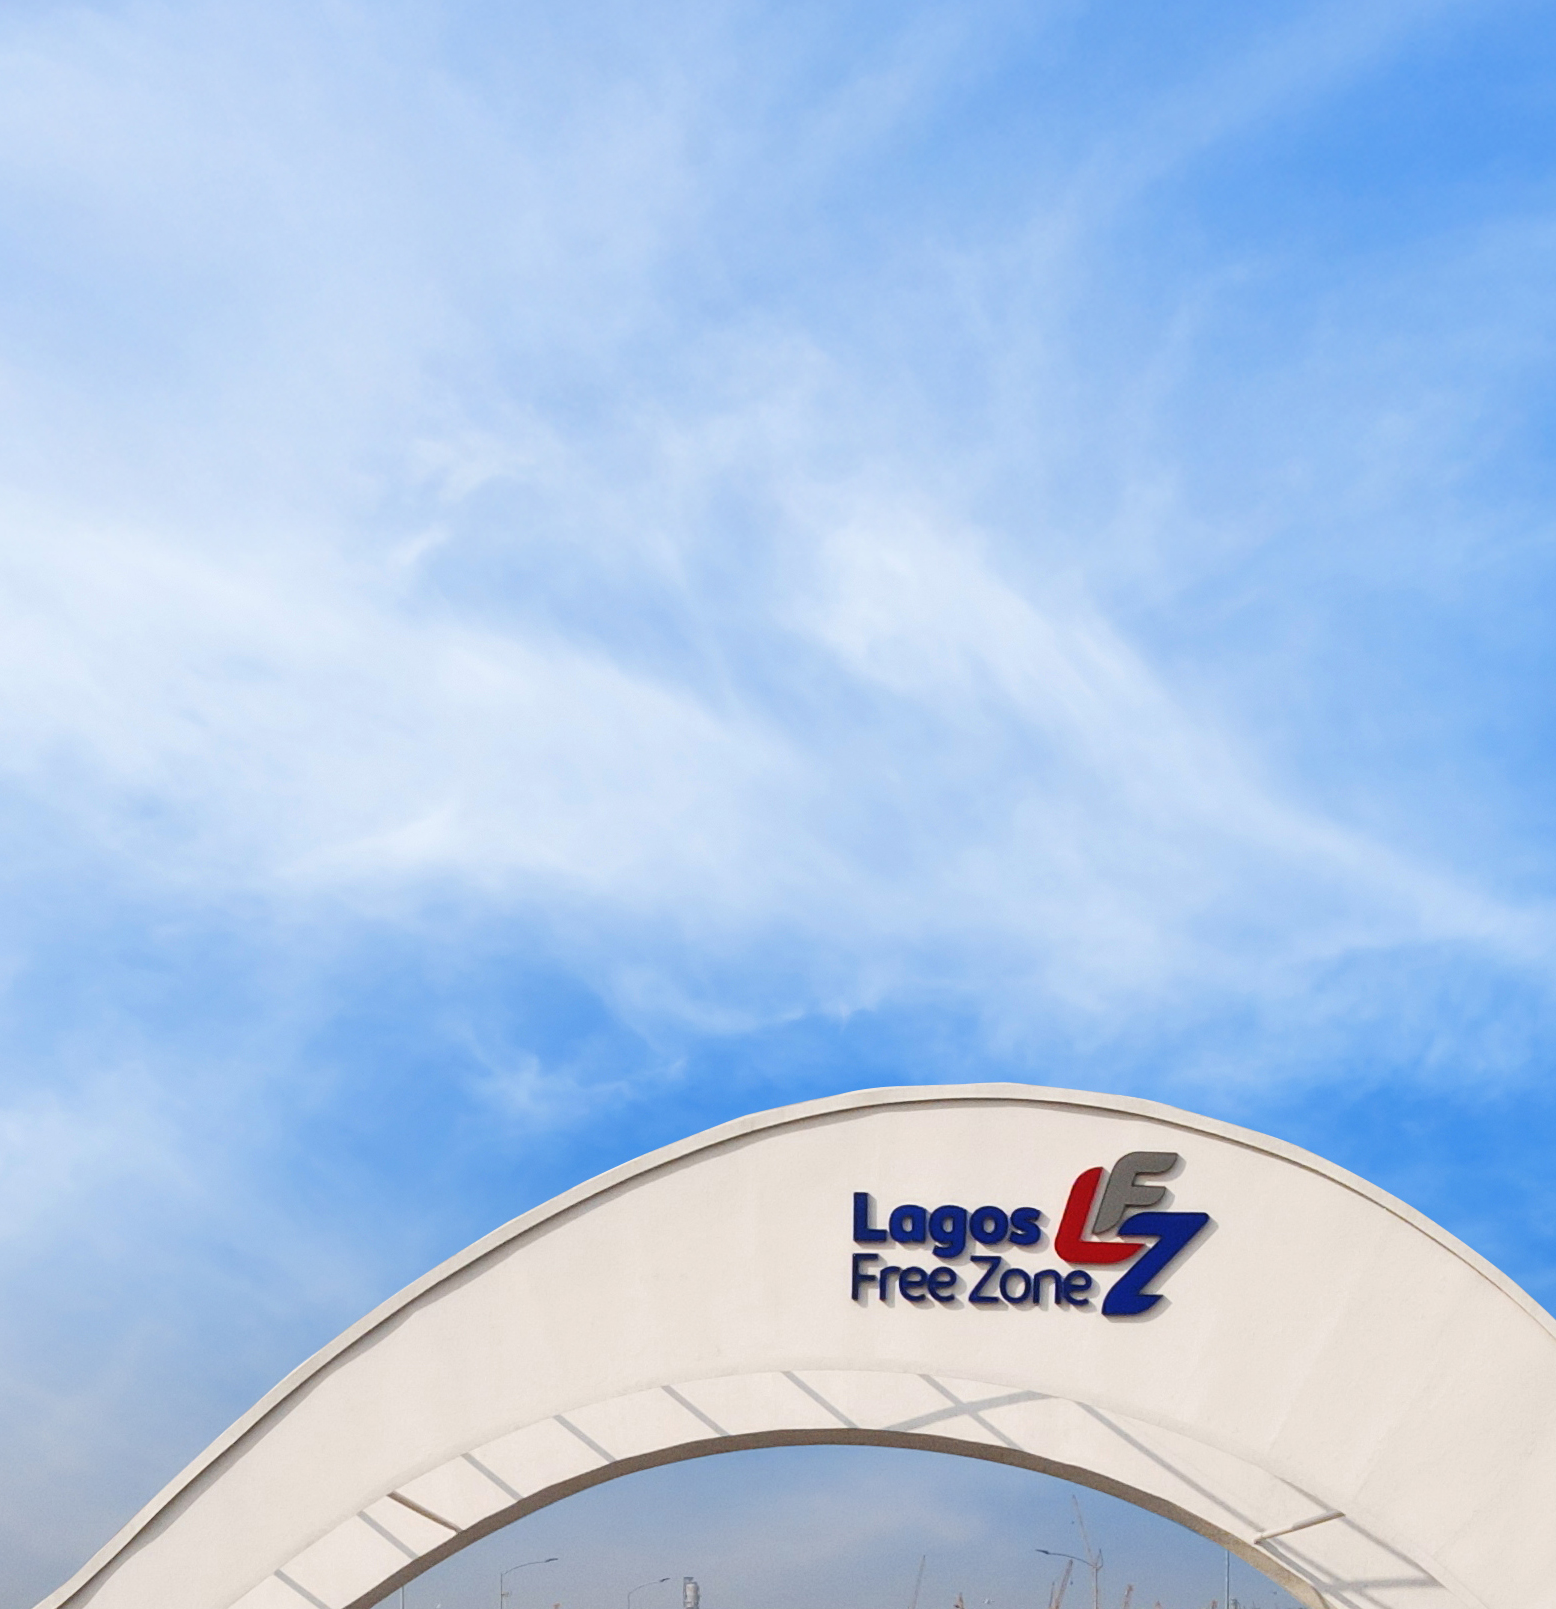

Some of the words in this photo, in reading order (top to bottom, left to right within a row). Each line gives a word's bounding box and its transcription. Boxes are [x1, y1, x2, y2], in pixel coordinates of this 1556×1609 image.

[853, 1192, 1041, 1258] Lagos
[851, 1253, 957, 1302] Free
[968, 1255, 1093, 1306] Zone
